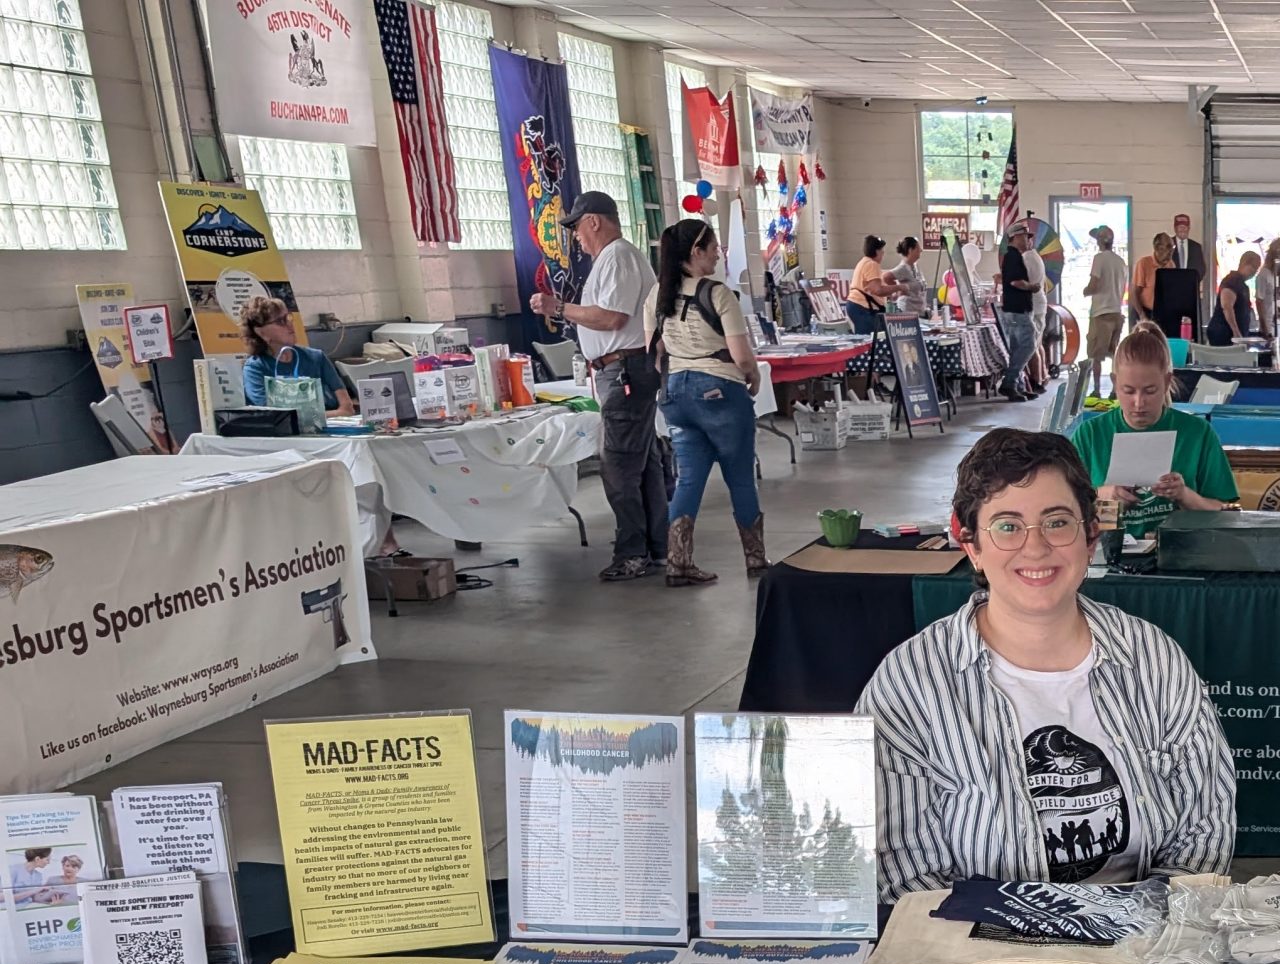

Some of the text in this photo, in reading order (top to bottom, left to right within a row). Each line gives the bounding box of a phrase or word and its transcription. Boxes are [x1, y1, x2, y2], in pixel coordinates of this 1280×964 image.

[267, 11, 332, 42] 46TH DISTRICT
[271, 101, 349, 124] BUCHTAN4PA.COM
[176, 188, 204, 197] DISCOVER
[1082, 186, 1099, 199] EXIT
[186, 235, 267, 248] CORNERSTONE
[136, 328, 159, 336] Children's
[889, 323, 917, 337] Welcome
[1120, 503, 1174, 518] ARMICHAELS
[93, 568, 240, 643] Sportsmen's
[244, 541, 346, 593] Association
[116, 656, 239, 707] Website: www.waysa.org
[1204, 681, 1231, 696] ind
[1236, 685, 1254, 696] us
[1258, 685, 1279, 697] on
[40, 652, 299, 759] Like us on facebook: Waynesburg Sportsmen's Association
[302, 736, 442, 767] MAD-FACTS
[561, 749, 630, 758] CHILDHOOD CANCER
[1230, 749, 1252, 758] ore
[345, 773, 409, 783] WWW.MAD-FACTS.ORG
[1028, 774, 1089, 786] CENTER FOR
[152, 794, 196, 804] Freeport,
[171, 800, 213, 808] without
[1035, 791, 1116, 809] LFIELD JUSTICE
[141, 807, 205, 817] safe drinking
[163, 824, 188, 832] year.
[309, 825, 341, 834] Without
[343, 823, 375, 832] changes
[387, 817, 437, 828] Pennsylvania
[138, 836, 154, 844] It's
[157, 835, 178, 843] time
[303, 825, 461, 844] addressing the environmental and public
[128, 896, 167, 904] SOMETHING
[150, 901, 184, 909] FREEPORT
[26, 919, 63, 937] EHP
